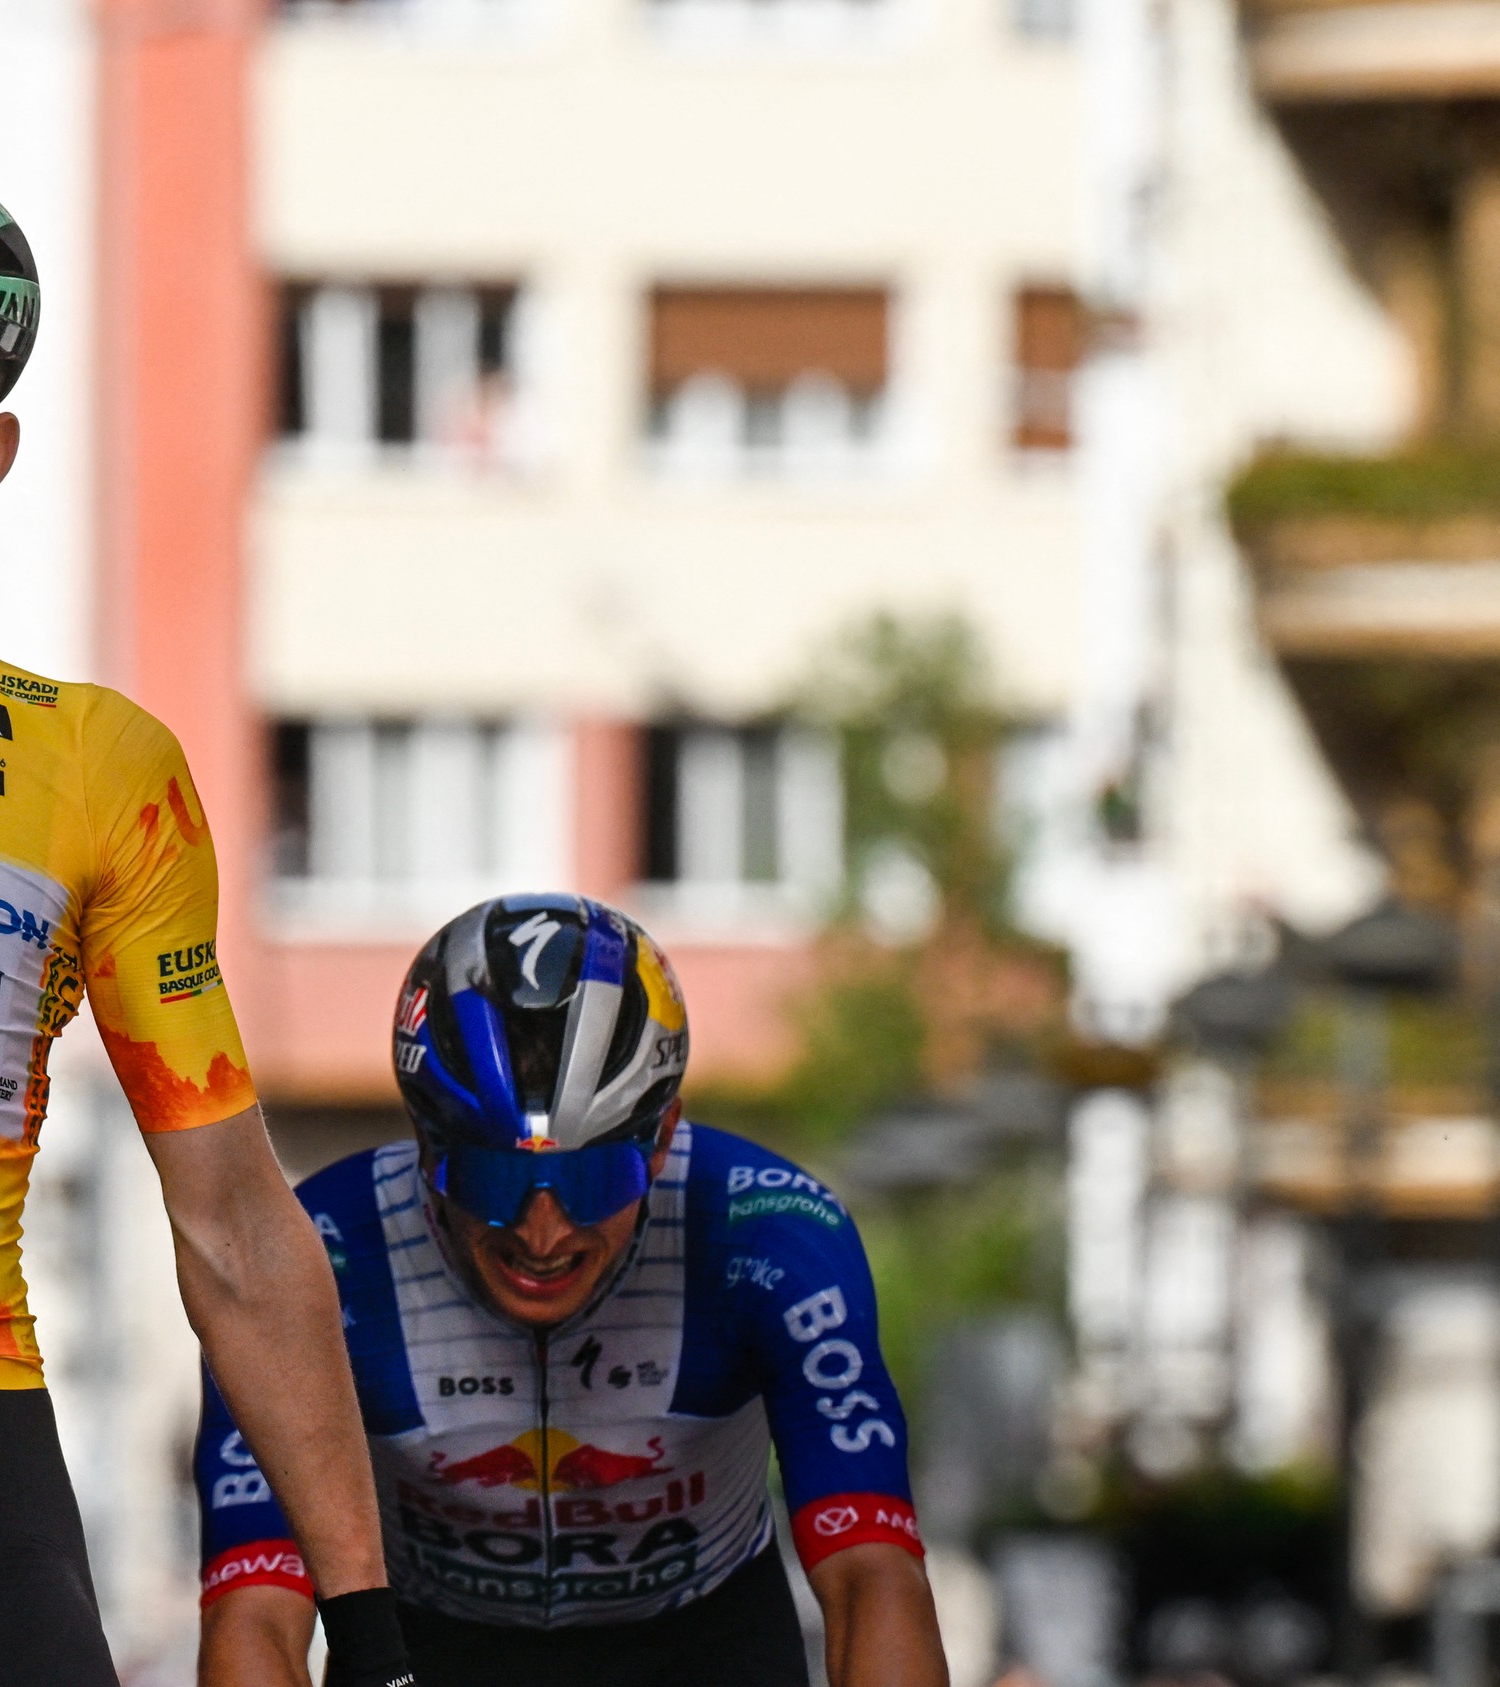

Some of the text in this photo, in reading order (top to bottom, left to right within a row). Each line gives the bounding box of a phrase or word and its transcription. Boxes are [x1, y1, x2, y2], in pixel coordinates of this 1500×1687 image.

[14, 691, 58, 704] COUNTRY
[157, 940, 217, 977] EUSK
[159, 972, 204, 995] BASQUE
[783, 1285, 896, 1453] BOSS
[438, 1376, 515, 1397] BOSS
[400, 1517, 700, 1569] BORA
